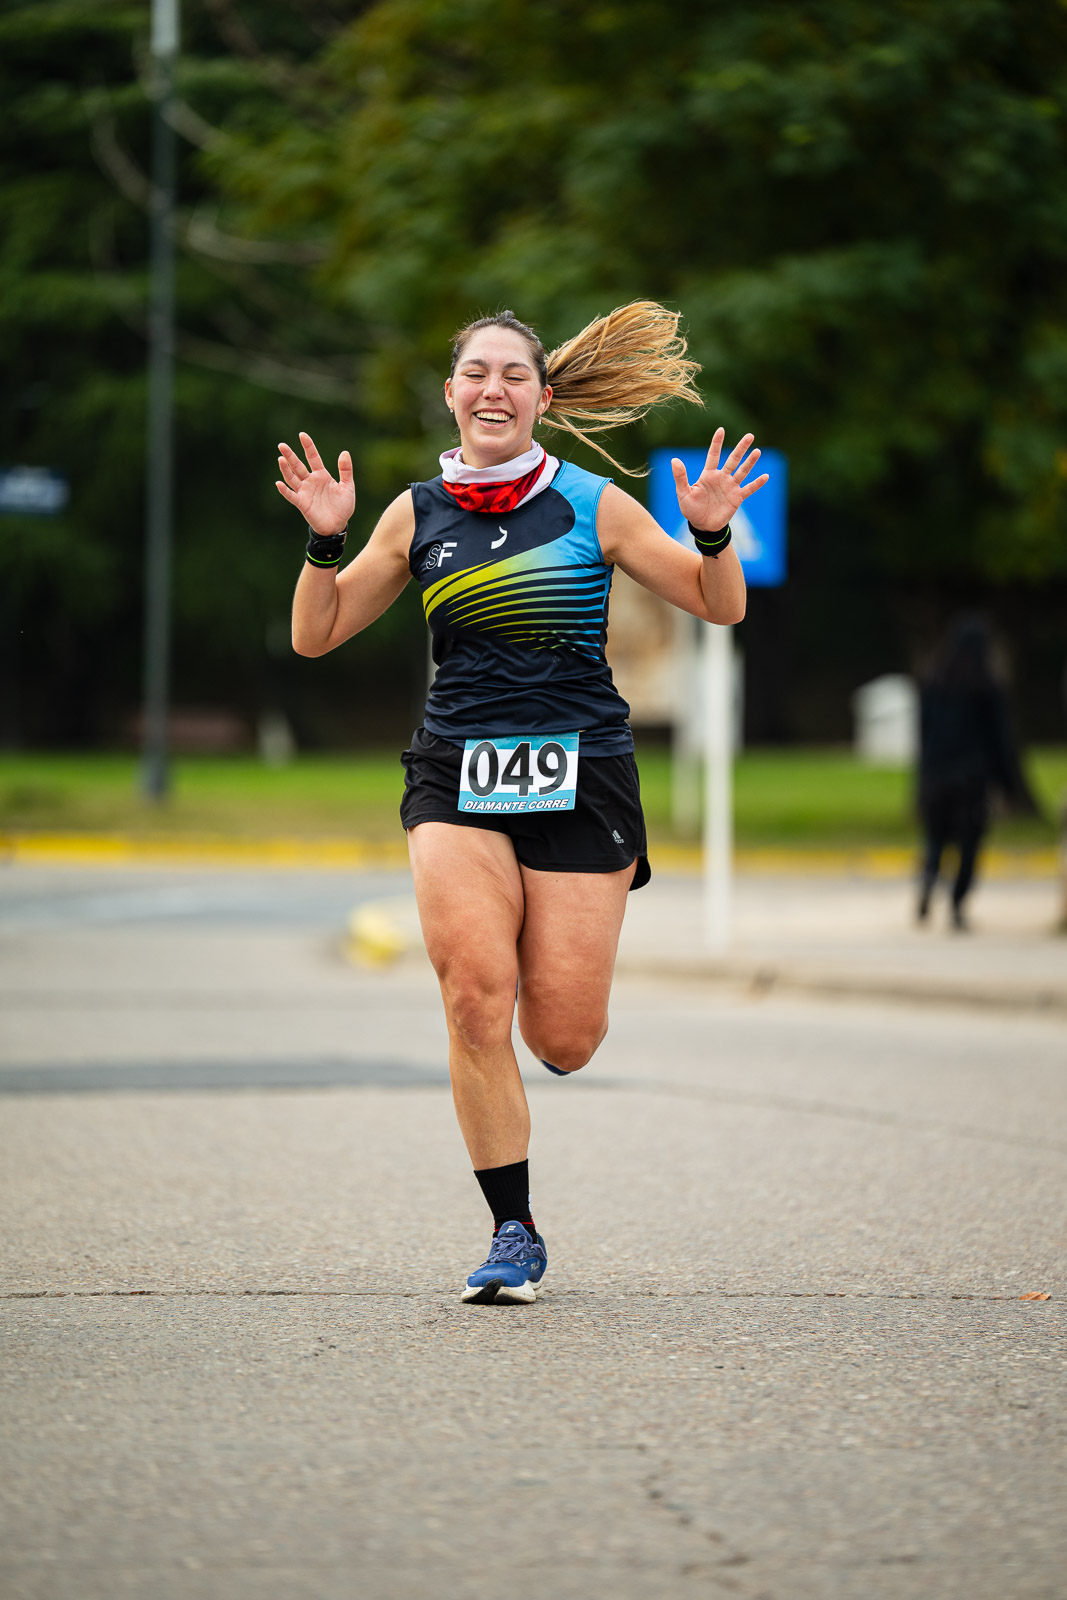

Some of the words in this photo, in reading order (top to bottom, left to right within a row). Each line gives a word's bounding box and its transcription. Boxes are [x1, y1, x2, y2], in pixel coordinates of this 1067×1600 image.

[425, 542, 458, 570] SF
[468, 741, 568, 797] 049
[463, 800, 527, 811] DIAMANTE
[528, 798, 569, 810] CORRE
